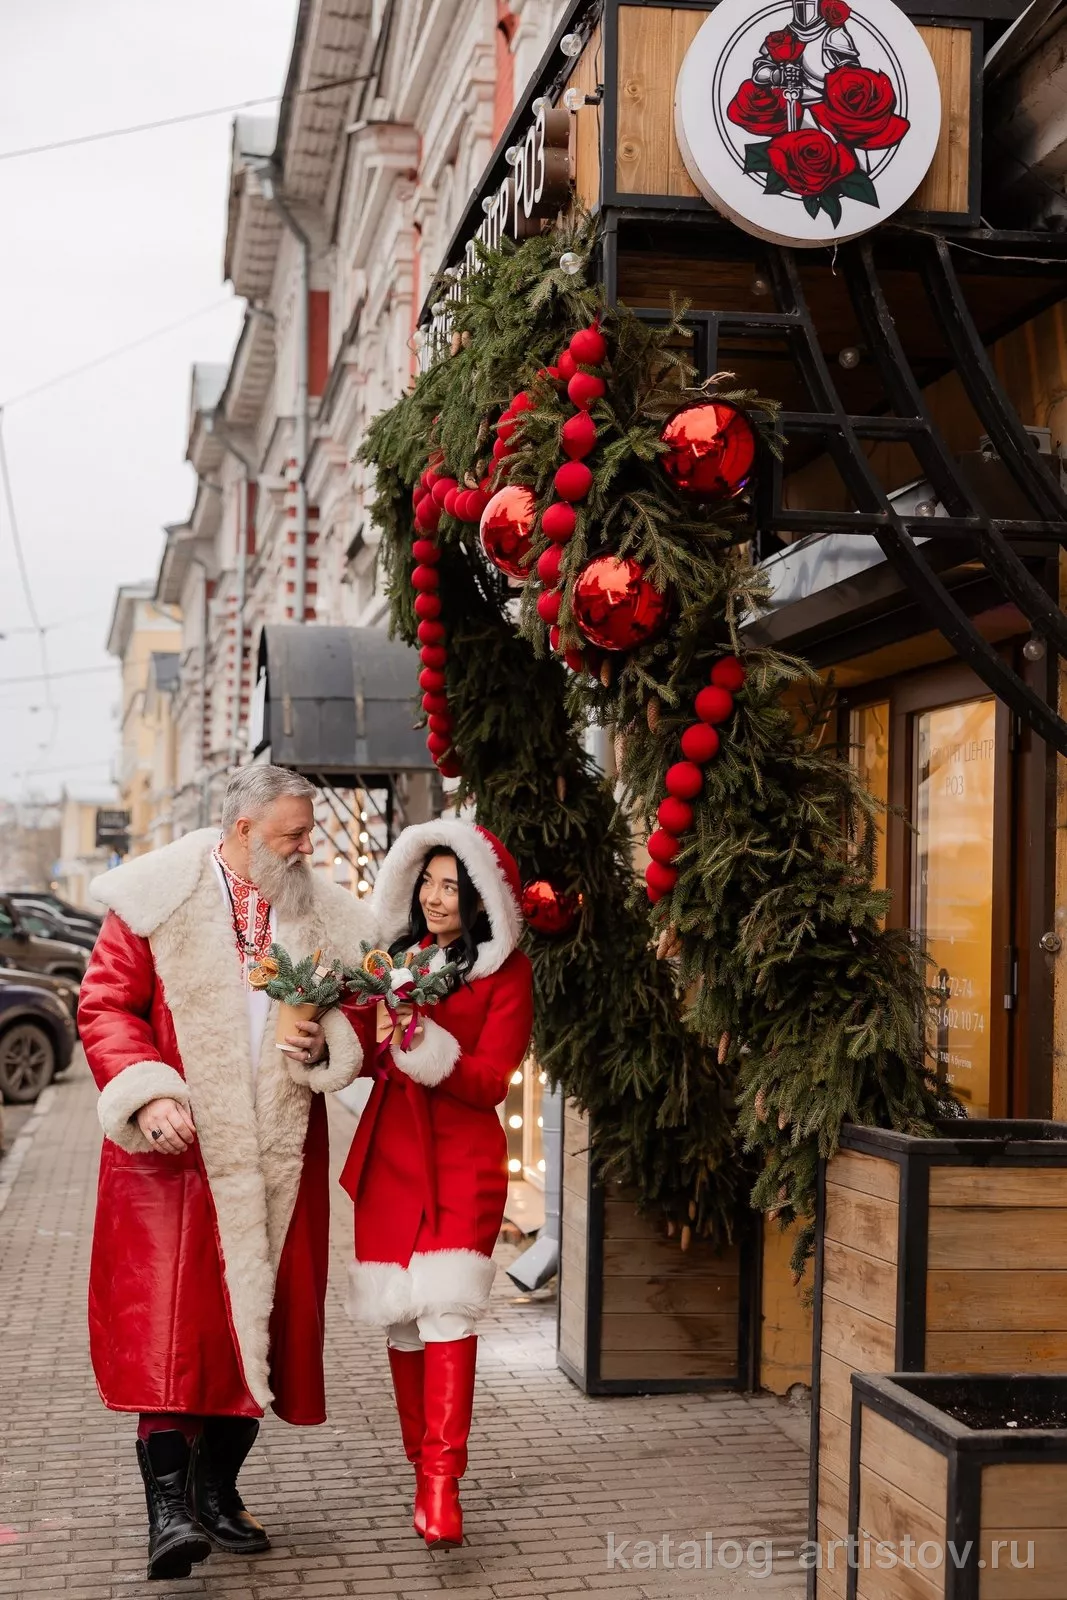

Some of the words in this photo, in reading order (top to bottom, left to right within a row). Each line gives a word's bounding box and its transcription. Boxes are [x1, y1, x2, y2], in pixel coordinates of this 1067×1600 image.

[514, 107, 545, 240] РОЗ
[965, 739, 994, 762] ЦЕНТР
[945, 775, 964, 797] РОЗ
[943, 1007, 959, 1029] 602
[961, 1011, 971, 1031] 10
[973, 1012, 984, 1033] 74
